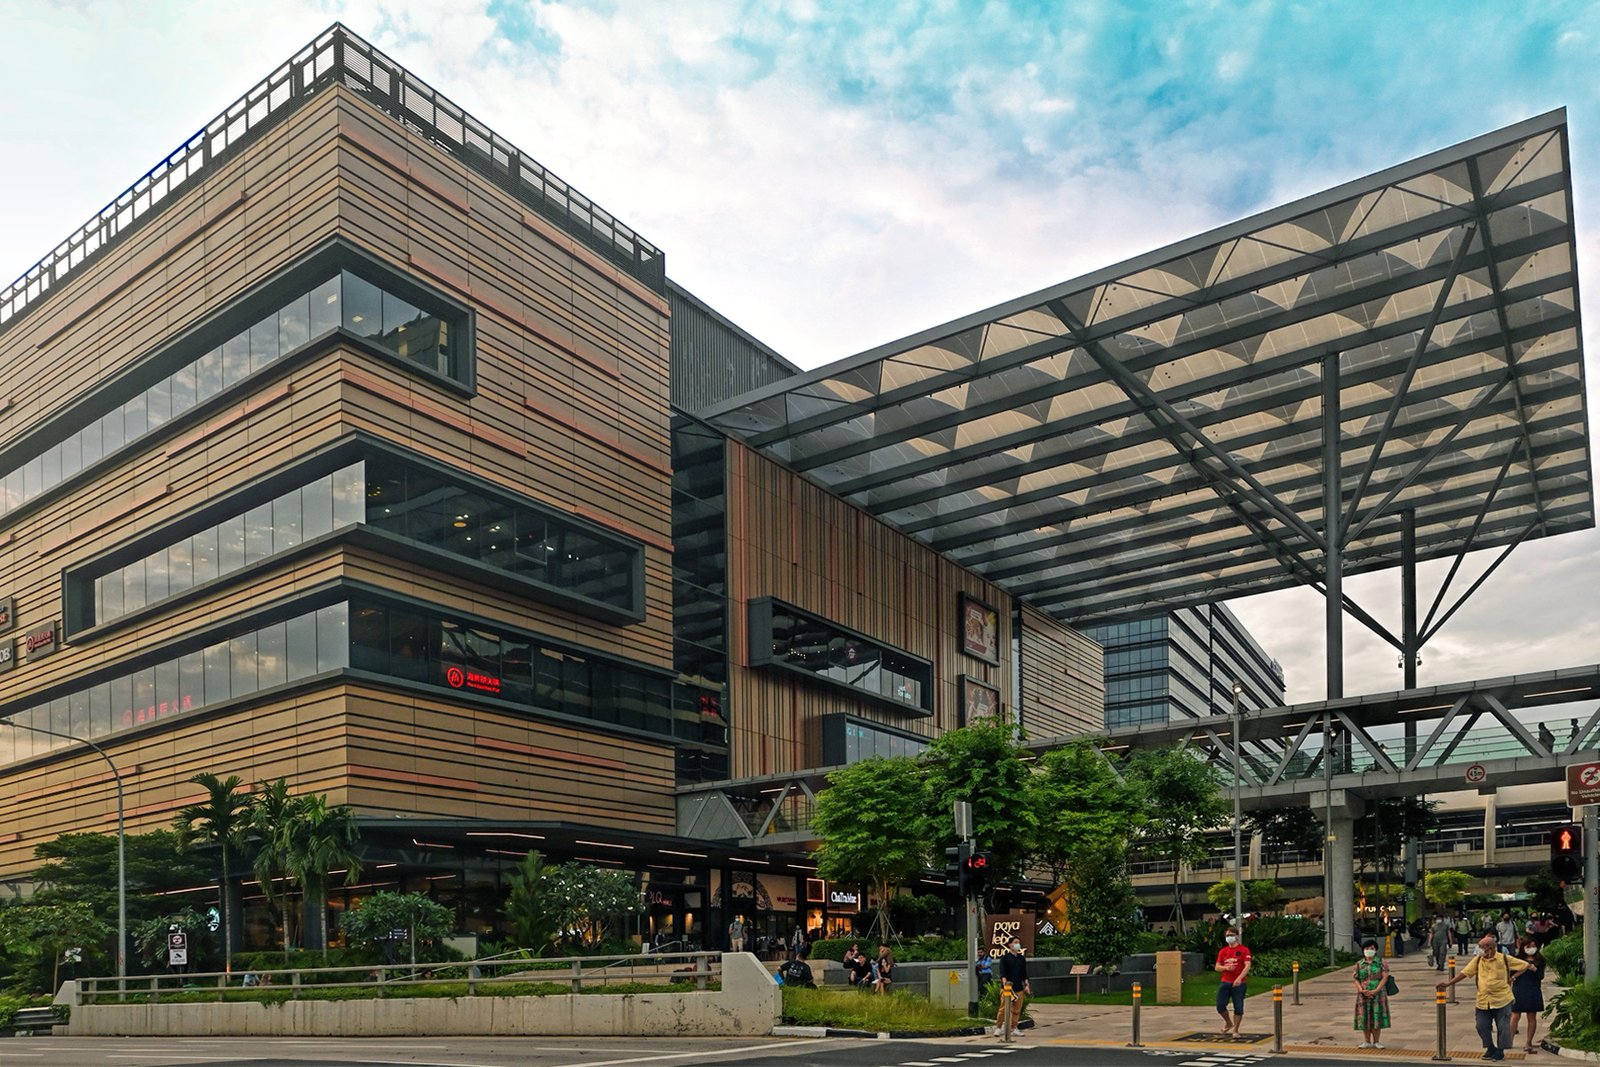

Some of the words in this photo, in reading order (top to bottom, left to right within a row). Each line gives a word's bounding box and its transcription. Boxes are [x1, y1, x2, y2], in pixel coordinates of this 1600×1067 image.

[993, 921, 1020, 932] paya
[992, 933, 1009, 945] leb
[990, 948, 1027, 960] quar
